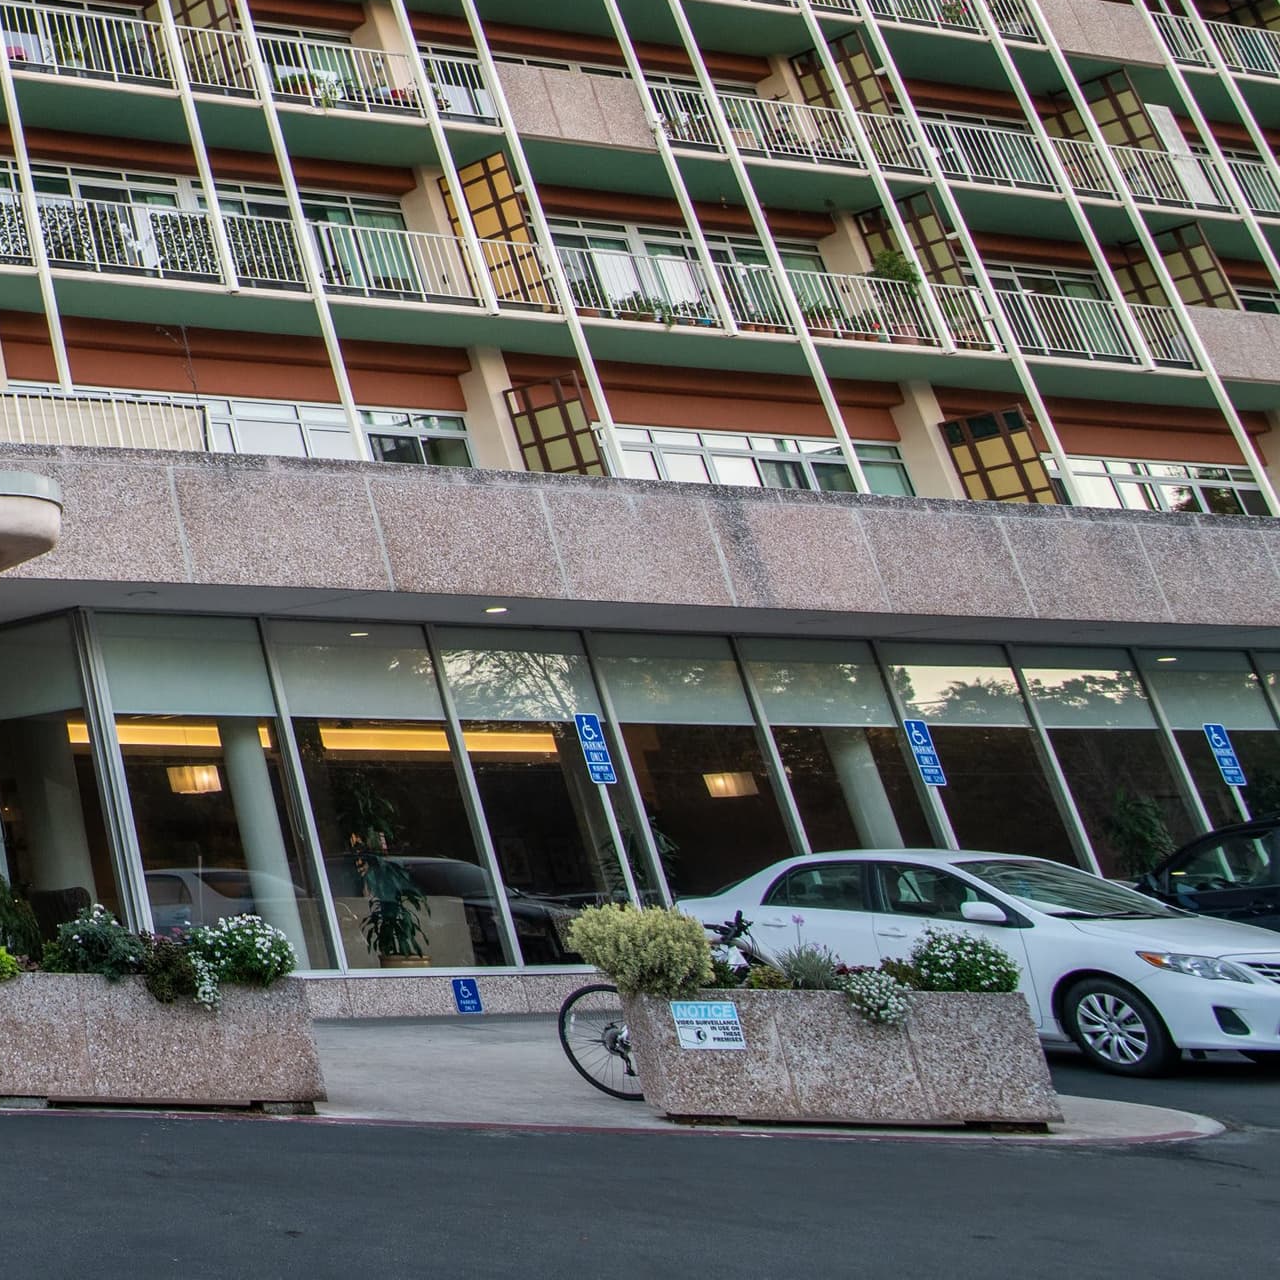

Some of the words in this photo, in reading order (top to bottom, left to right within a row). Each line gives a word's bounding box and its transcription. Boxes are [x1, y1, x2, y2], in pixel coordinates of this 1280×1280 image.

[583, 741, 606, 750] PARKING
[913, 746, 935, 754] PARKING
[590, 752, 603, 761] ONLY
[920, 756, 934, 764] ONLY
[676, 1005, 733, 1017] NOTICE
